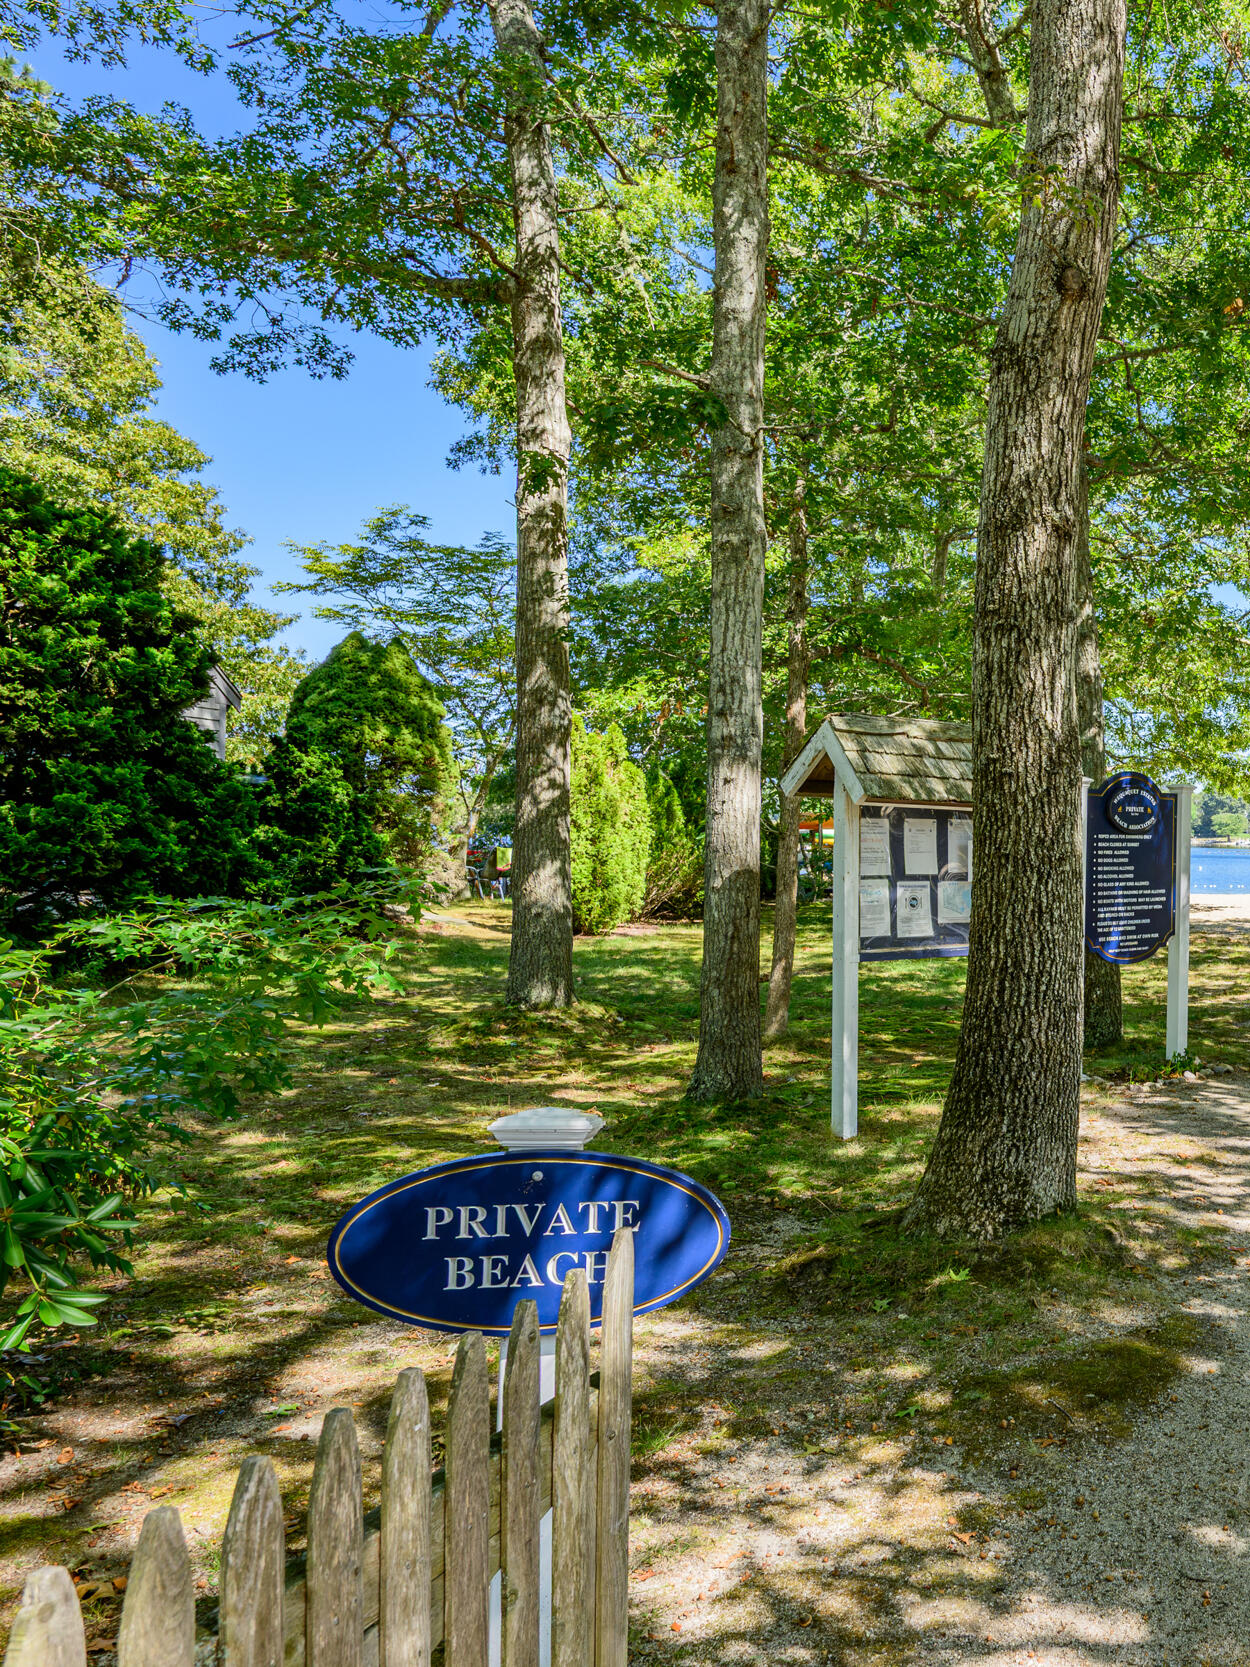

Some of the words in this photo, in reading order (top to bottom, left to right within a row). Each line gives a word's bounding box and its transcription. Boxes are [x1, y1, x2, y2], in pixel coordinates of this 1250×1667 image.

[1114, 814, 1128, 828] BEACH
[422, 1200, 641, 1240] PRIVATE
[443, 1250, 612, 1291] BEACH
